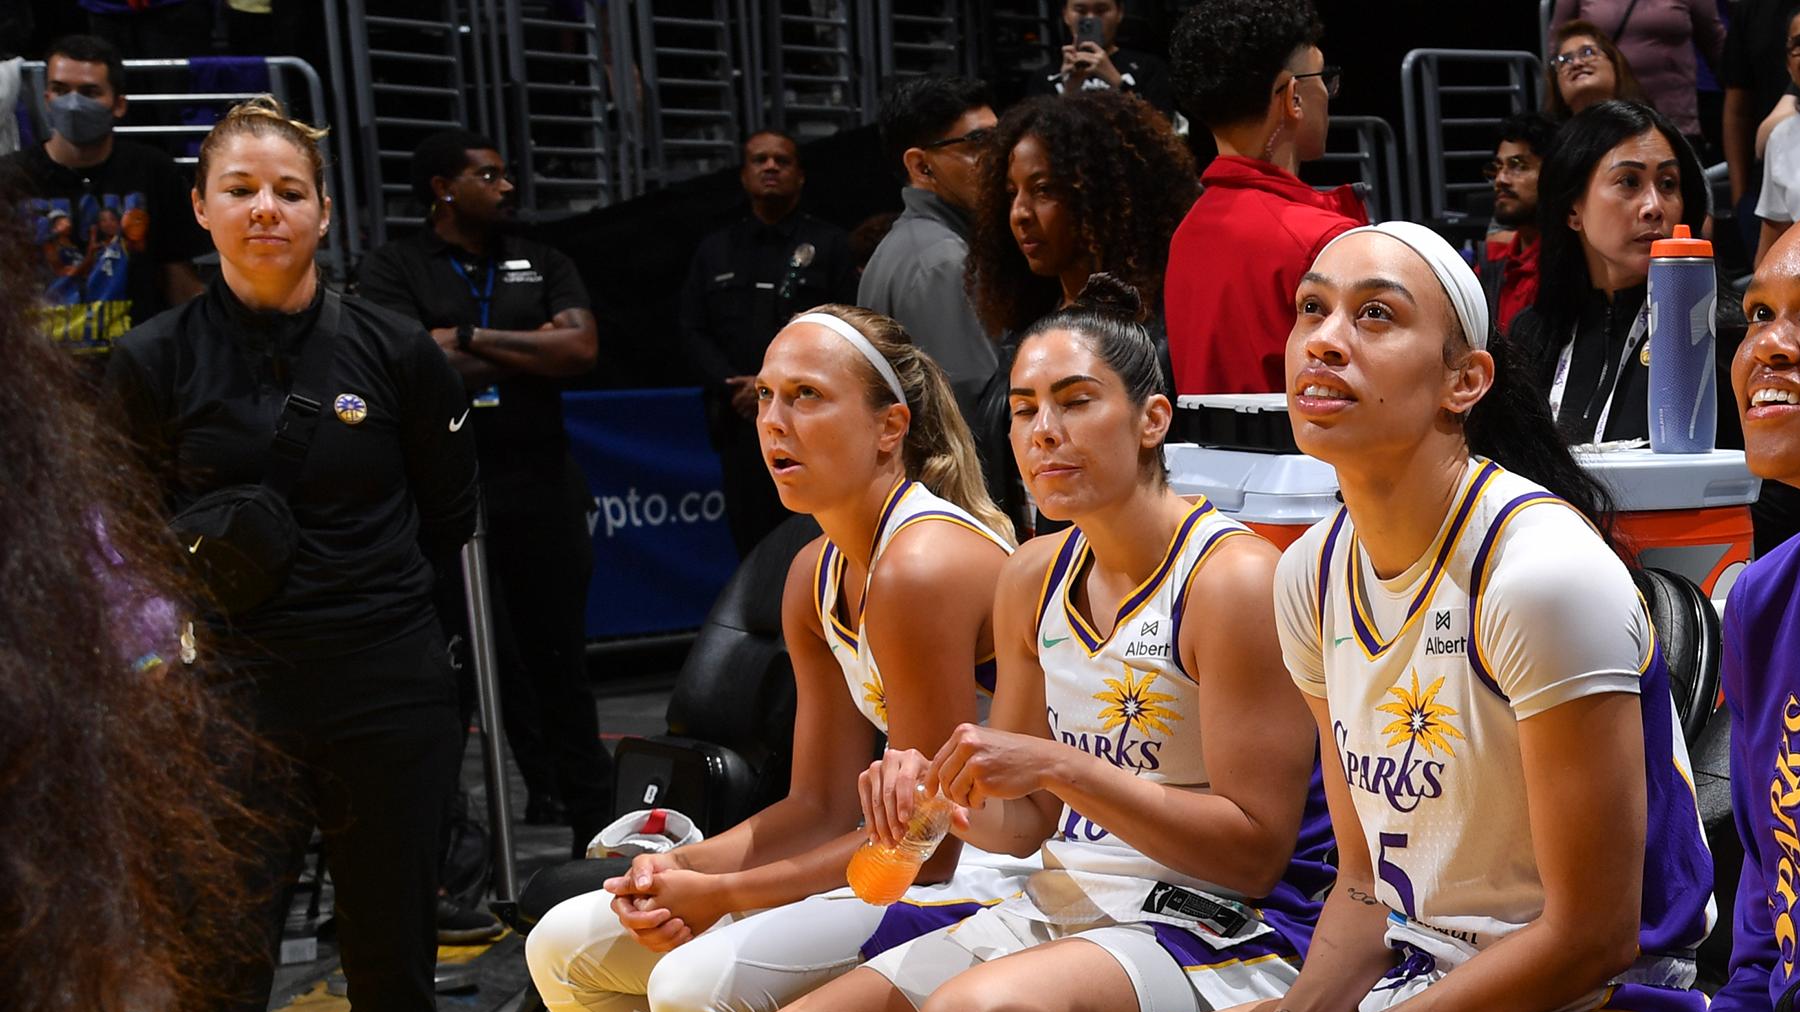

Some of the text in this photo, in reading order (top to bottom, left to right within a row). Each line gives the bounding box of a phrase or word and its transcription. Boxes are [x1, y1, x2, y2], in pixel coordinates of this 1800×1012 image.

[1125, 641, 1170, 657] Albert
[1425, 636, 1467, 656] Albert
[1334, 719, 1445, 813] SPARKS
[1378, 832, 1415, 918] 5
